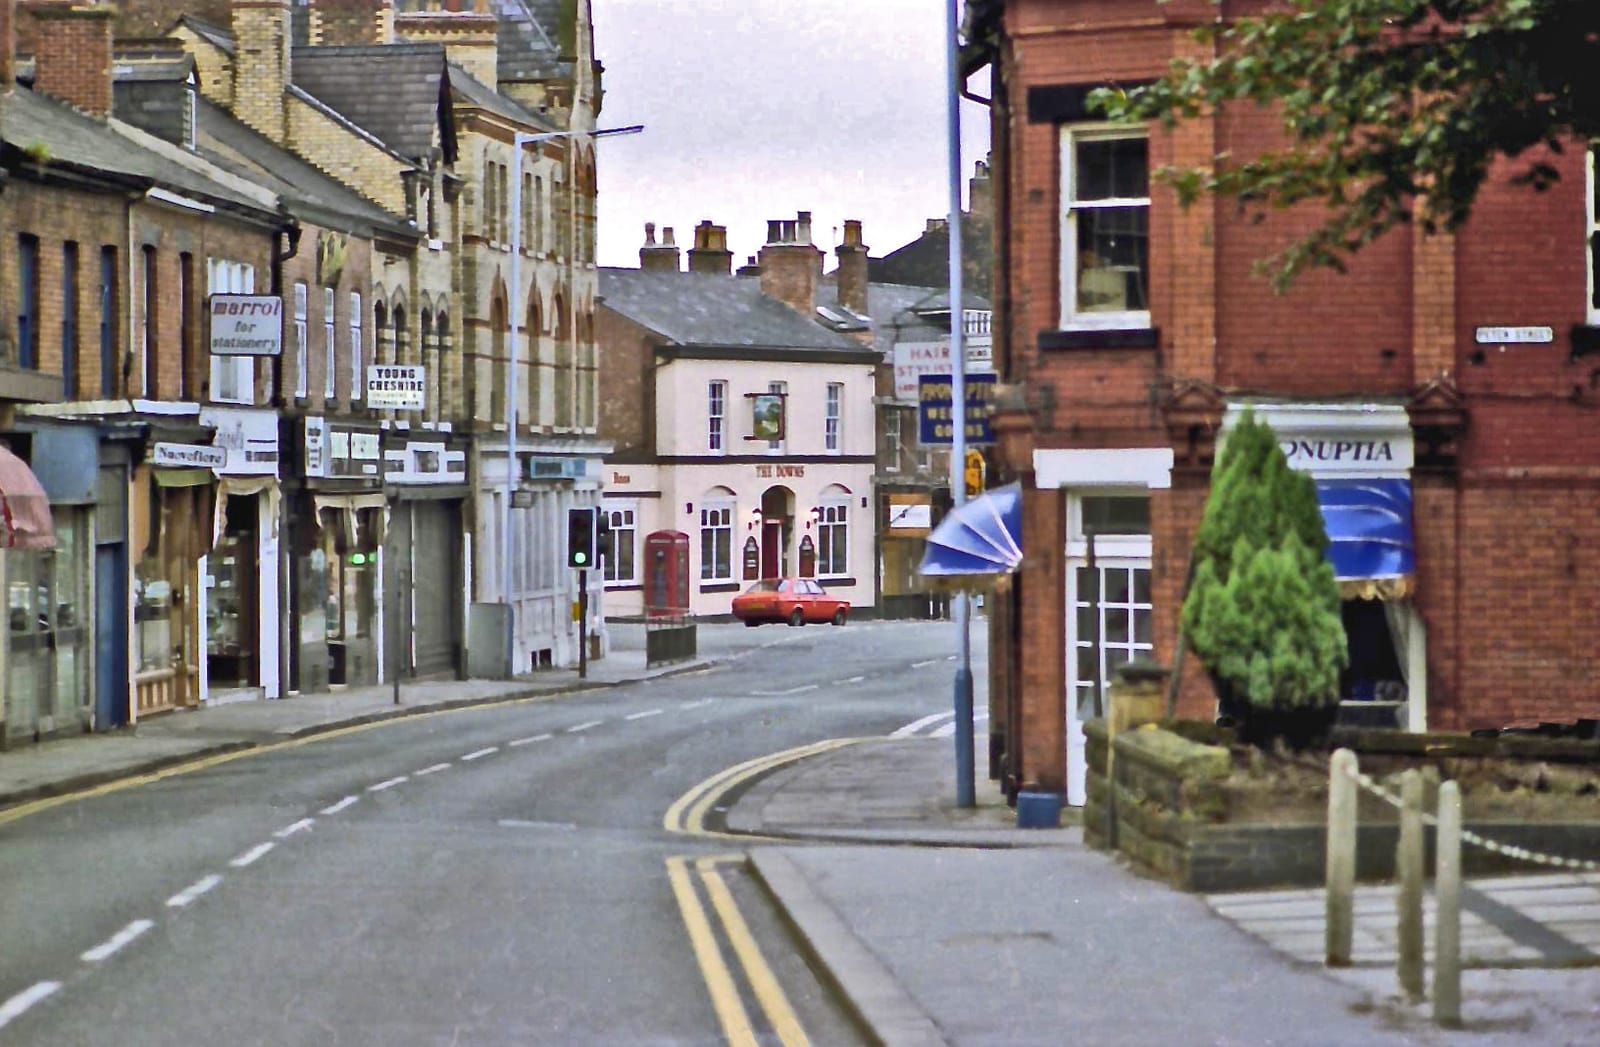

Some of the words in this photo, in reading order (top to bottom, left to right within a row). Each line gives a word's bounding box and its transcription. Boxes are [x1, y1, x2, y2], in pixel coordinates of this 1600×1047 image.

[234, 320, 257, 333] for
[910, 347, 950, 361] HAIR
[376, 368, 416, 379] YOUNG
[369, 380, 423, 391] CHESHIRE
[755, 465, 772, 478] THE
